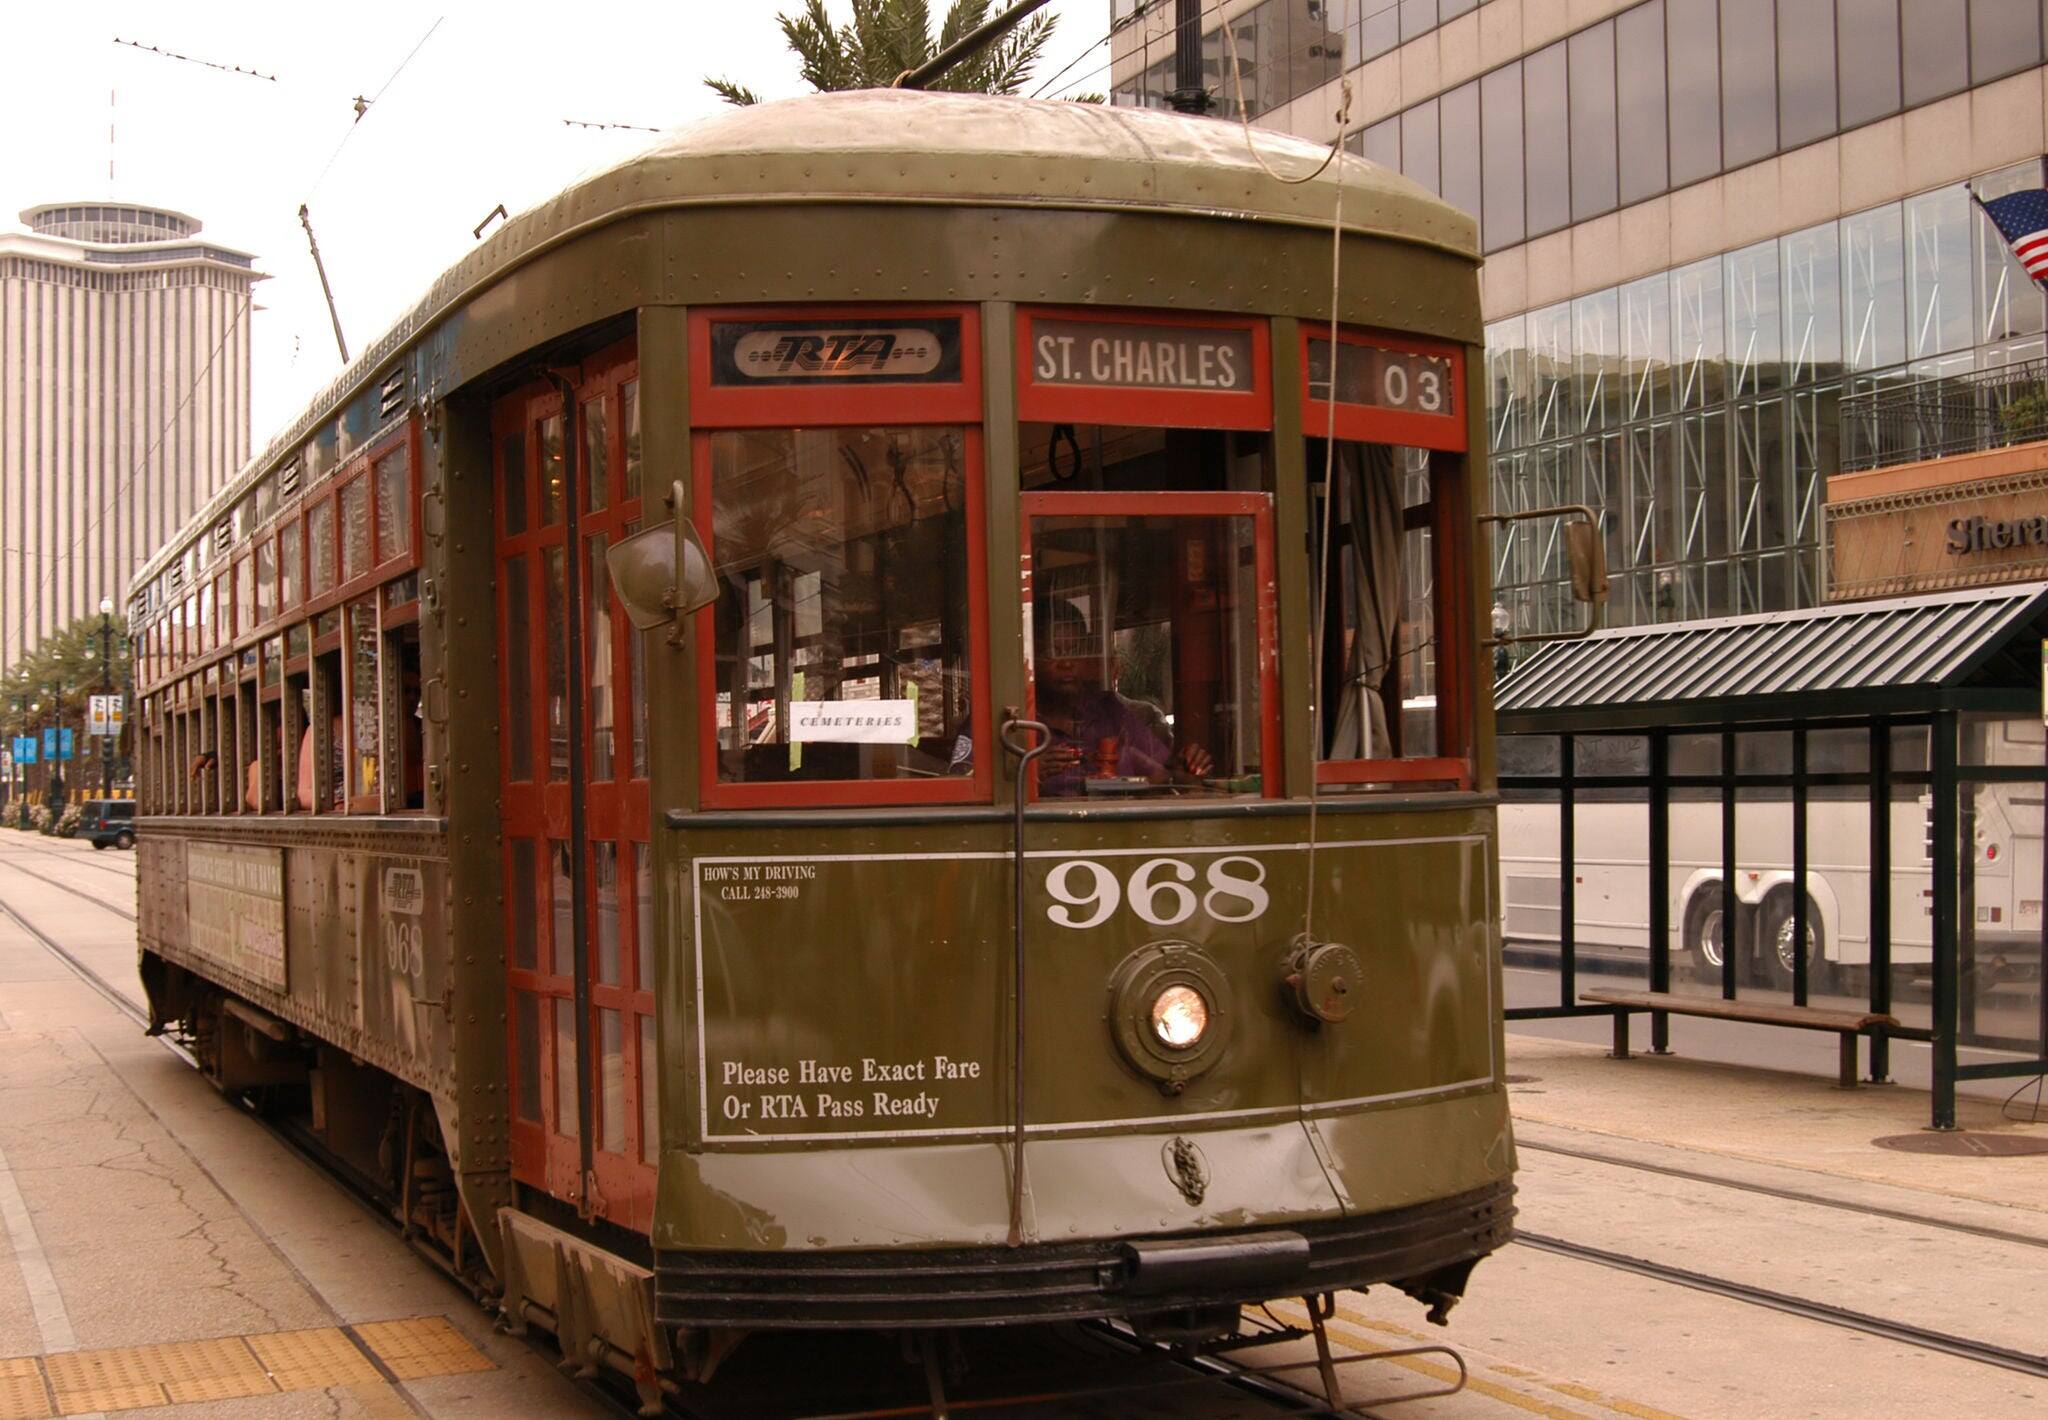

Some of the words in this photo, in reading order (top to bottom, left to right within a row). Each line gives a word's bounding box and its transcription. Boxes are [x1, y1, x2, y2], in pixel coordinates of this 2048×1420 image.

[776, 334, 897, 373] RTA
[1038, 335, 1082, 380] ST.
[1090, 339, 1236, 388] CHARLES
[1384, 364, 1441, 411] 03
[800, 717, 902, 728] CEMETERIES
[704, 866, 739, 881] HOW'S
[743, 866, 761, 880] MY
[765, 865, 816, 880] DRIVING
[721, 886, 751, 900] CALL
[754, 886, 799, 900] 248-3900
[1045, 856, 1269, 929] 968
[387, 921, 423, 977] 968
[722, 1061, 789, 1085] Please
[799, 1060, 853, 1083] Have
[862, 1057, 925, 1082] Exact
[934, 1056, 981, 1080] Fare
[723, 1095, 751, 1119] Or
[761, 1094, 808, 1118] RTA
[817, 1093, 864, 1117] Pass
[873, 1091, 940, 1117] Ready
